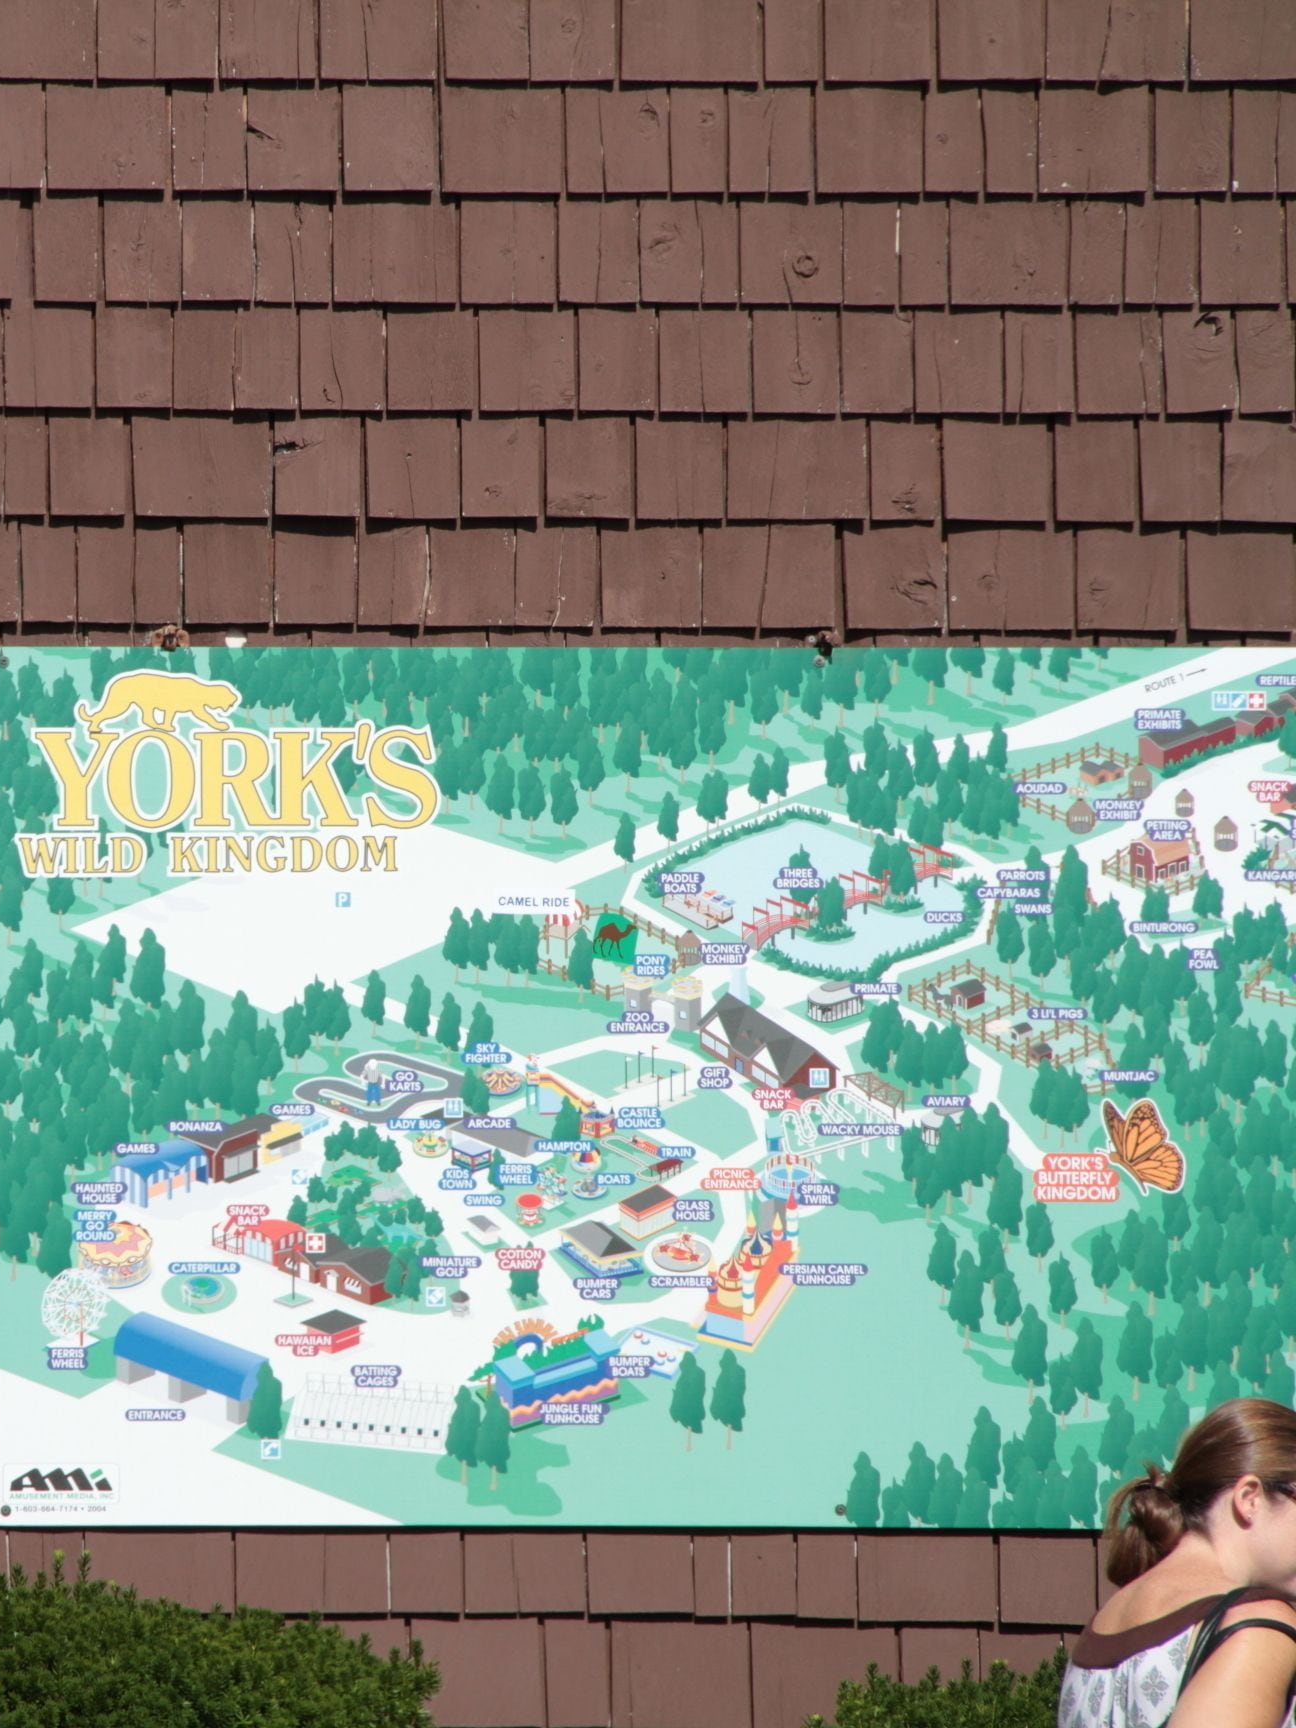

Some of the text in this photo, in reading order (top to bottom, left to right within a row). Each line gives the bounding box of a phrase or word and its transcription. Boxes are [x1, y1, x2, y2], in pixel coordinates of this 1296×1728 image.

[1144, 675, 1177, 693] ROUTE
[1137, 710, 1182, 719] PRIMATE
[1138, 720, 1182, 730] EXHIBITS
[35, 723, 439, 829] YORK'S
[1015, 783, 1064, 794] AOUDAD
[1250, 782, 1289, 792] SNACK
[1259, 792, 1281, 801] BAR
[1095, 800, 1143, 810] MONKEY
[1099, 810, 1138, 820] EXHIBIT
[1146, 821, 1188, 831] PETTING
[1153, 831, 1182, 840] AREA
[18, 835, 398, 874] WILD KINGDOM
[661, 873, 700, 883] PADDLE
[783, 868, 813, 878] THREE
[1000, 871, 1046, 880] PARROTS
[664, 883, 697, 893] BOATS
[776, 878, 820, 888] BRIDGES
[977, 888, 1040, 898] CAPYBARAS
[498, 896, 570, 907] CAMEL RIDE
[1014, 904, 1052, 913] SWANS
[926, 912, 963, 922] DUCKS
[1132, 922, 1195, 932] BINTURONG
[701, 944, 748, 954] MONKEY
[705, 954, 744, 964] EXHIBIT
[1193, 950, 1214, 959] PEA
[636, 956, 666, 965] PONY
[1188, 960, 1219, 969] FOWL
[637, 965, 666, 975] RIDES
[854, 984, 898, 993] PRIMATE
[625, 1013, 649, 1022] ZOO
[1031, 1009, 1039, 1019] 3
[1058, 1009, 1084, 1019] PIGS
[610, 1023, 665, 1033] ENTRANCE
[475, 1043, 497, 1053] SKY
[465, 1053, 507, 1063] FIGHTER
[395, 1072, 414, 1081] GO
[703, 1068, 727, 1078] GIFT
[1103, 1071, 1155, 1081] MUNTJAC
[389, 1082, 422, 1092] KARTS
[700, 1078, 730, 1087] SHOP
[754, 1089, 791, 1099] SNACK
[763, 1100, 784, 1109] BAR
[926, 1096, 966, 1106] AVIARY
[272, 1105, 312, 1116] GAMES
[620, 1108, 657, 1118] CASTLE
[169, 1121, 223, 1131] BONANZA
[389, 1119, 441, 1129] LADY BUG
[467, 1119, 511, 1129] ARCADE
[617, 1118, 662, 1128] BOUNCE
[821, 1125, 900, 1135] WACKY MOUSE
[116, 1143, 156, 1153] GAMES
[538, 1141, 591, 1151] HAMPTON
[661, 1148, 692, 1157] TRAIN
[1048, 1156, 1104, 1170] YORK'S
[446, 1169, 469, 1179] KIDS
[499, 1165, 532, 1174] FERRIS
[713, 1169, 752, 1178] PICNIC
[499, 1175, 534, 1184] WHEEL
[597, 1175, 631, 1184] BOATS
[1038, 1171, 1113, 1185] BUTTERFLY
[75, 1183, 123, 1193] HAUNTED
[441, 1179, 473, 1189] TOWN
[704, 1179, 759, 1189] ENTRANCE
[801, 1185, 836, 1194] SPIRAL
[1037, 1186, 1116, 1200] KINGDOM
[82, 1193, 117, 1203] HOUSE
[466, 1195, 502, 1205] SWING
[804, 1195, 833, 1204] TWIRL
[229, 1206, 266, 1215] SNACK
[676, 1201, 710, 1210] GLASS
[77, 1211, 113, 1220] MERRY
[237, 1216, 258, 1225] BAR
[675, 1211, 711, 1221] HOUSE
[85, 1221, 104, 1231] GO
[76, 1231, 115, 1241] ROUND
[498, 1249, 542, 1259] COTTON
[422, 1257, 478, 1267] MINIATURE
[500, 1259, 539, 1269] CANDY
[171, 1263, 237, 1273] CATERPILLAR
[435, 1267, 465, 1277] GOLF
[783, 1265, 865, 1274] PERSIAN CAMEL
[576, 1279, 618, 1289] BUMPER
[650, 1277, 713, 1287] SCRAMBLER
[796, 1275, 851, 1284] FUNHOUSE
[582, 1289, 612, 1299] CARS
[277, 1335, 332, 1345] HAWAIIAN
[51, 1349, 85, 1358] FERRIS
[296, 1346, 315, 1355] ICE
[51, 1359, 85, 1369] WHEEL
[609, 1357, 651, 1367] BUMPER
[354, 1367, 398, 1376] BATTING
[612, 1367, 645, 1377] BOATS
[357, 1376, 395, 1386] CAGES
[540, 1404, 602, 1414] JUNGLE FUN
[127, 1410, 183, 1420] ENTRANCE
[545, 1414, 600, 1424] FUNHOUSE
[9, 1492, 64, 1500] AMUSEMENT
[87, 1505, 107, 1513] 2004
